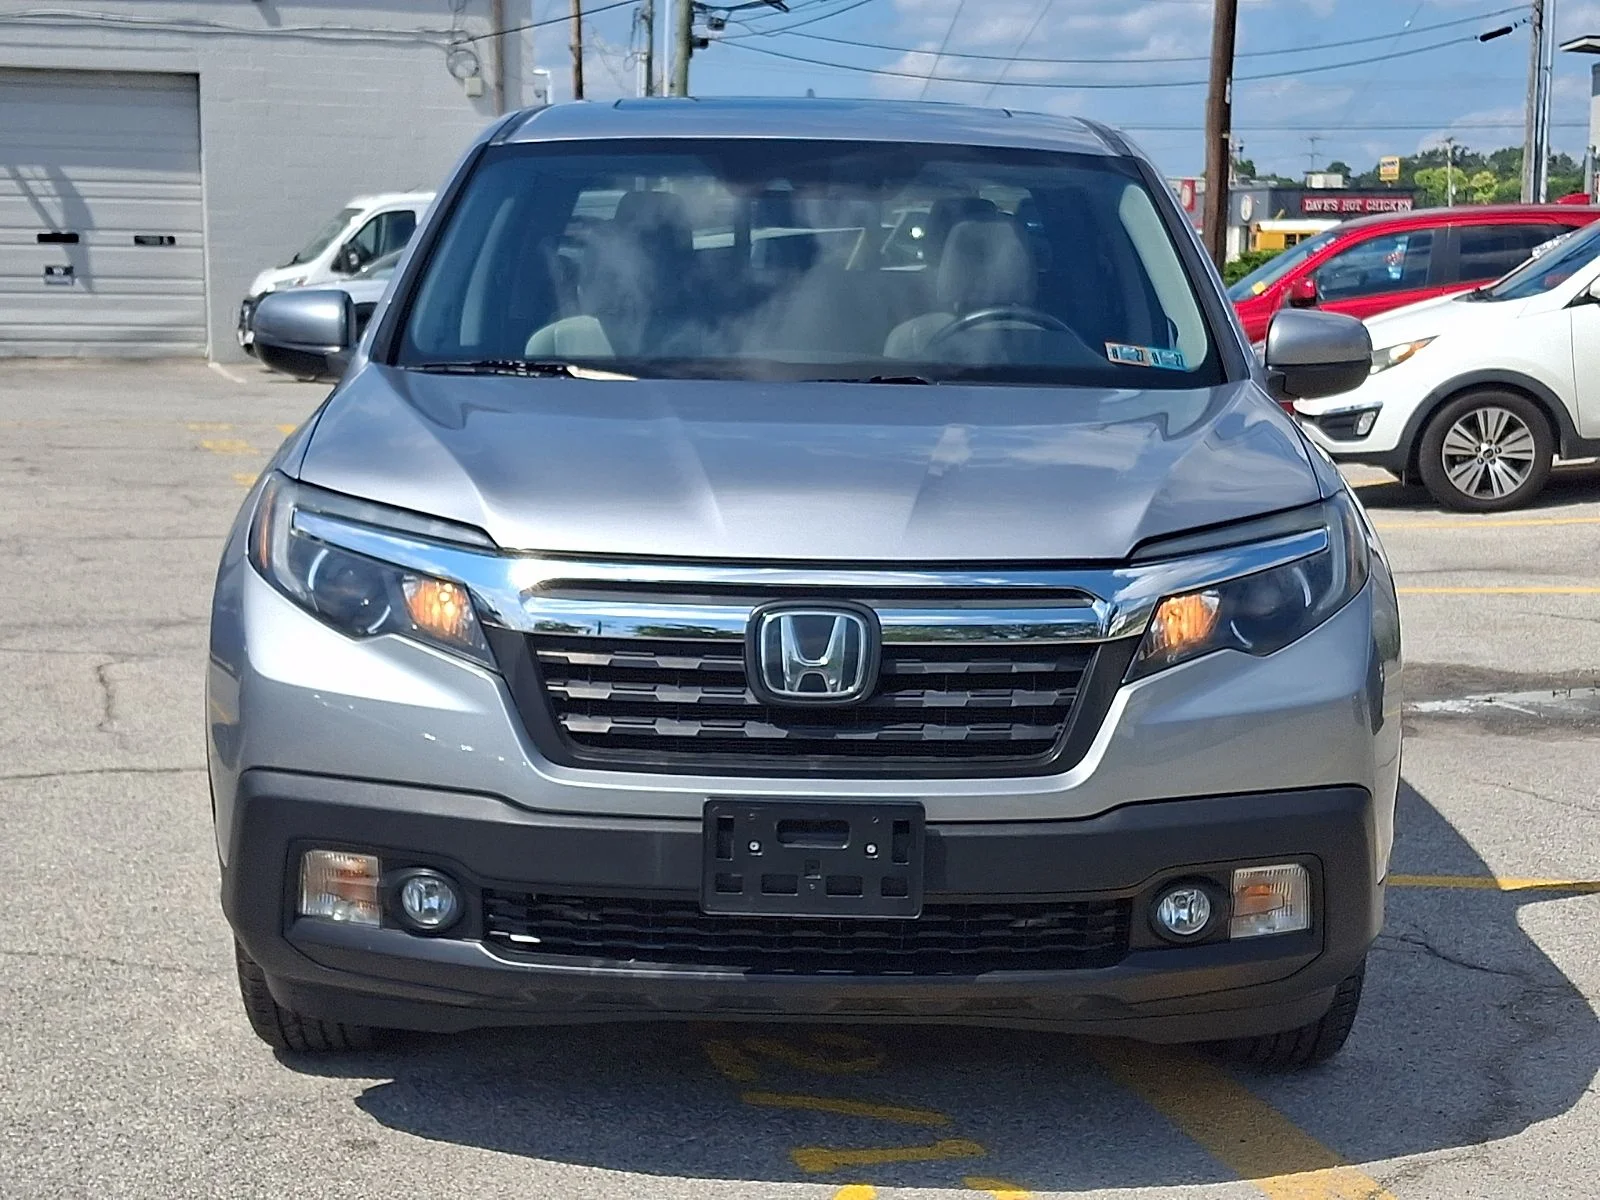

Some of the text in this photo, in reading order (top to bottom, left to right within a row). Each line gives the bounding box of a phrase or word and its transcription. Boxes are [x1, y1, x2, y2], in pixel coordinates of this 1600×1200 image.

[1304, 199, 1413, 212] DAVE'S HOT CHICKEN
